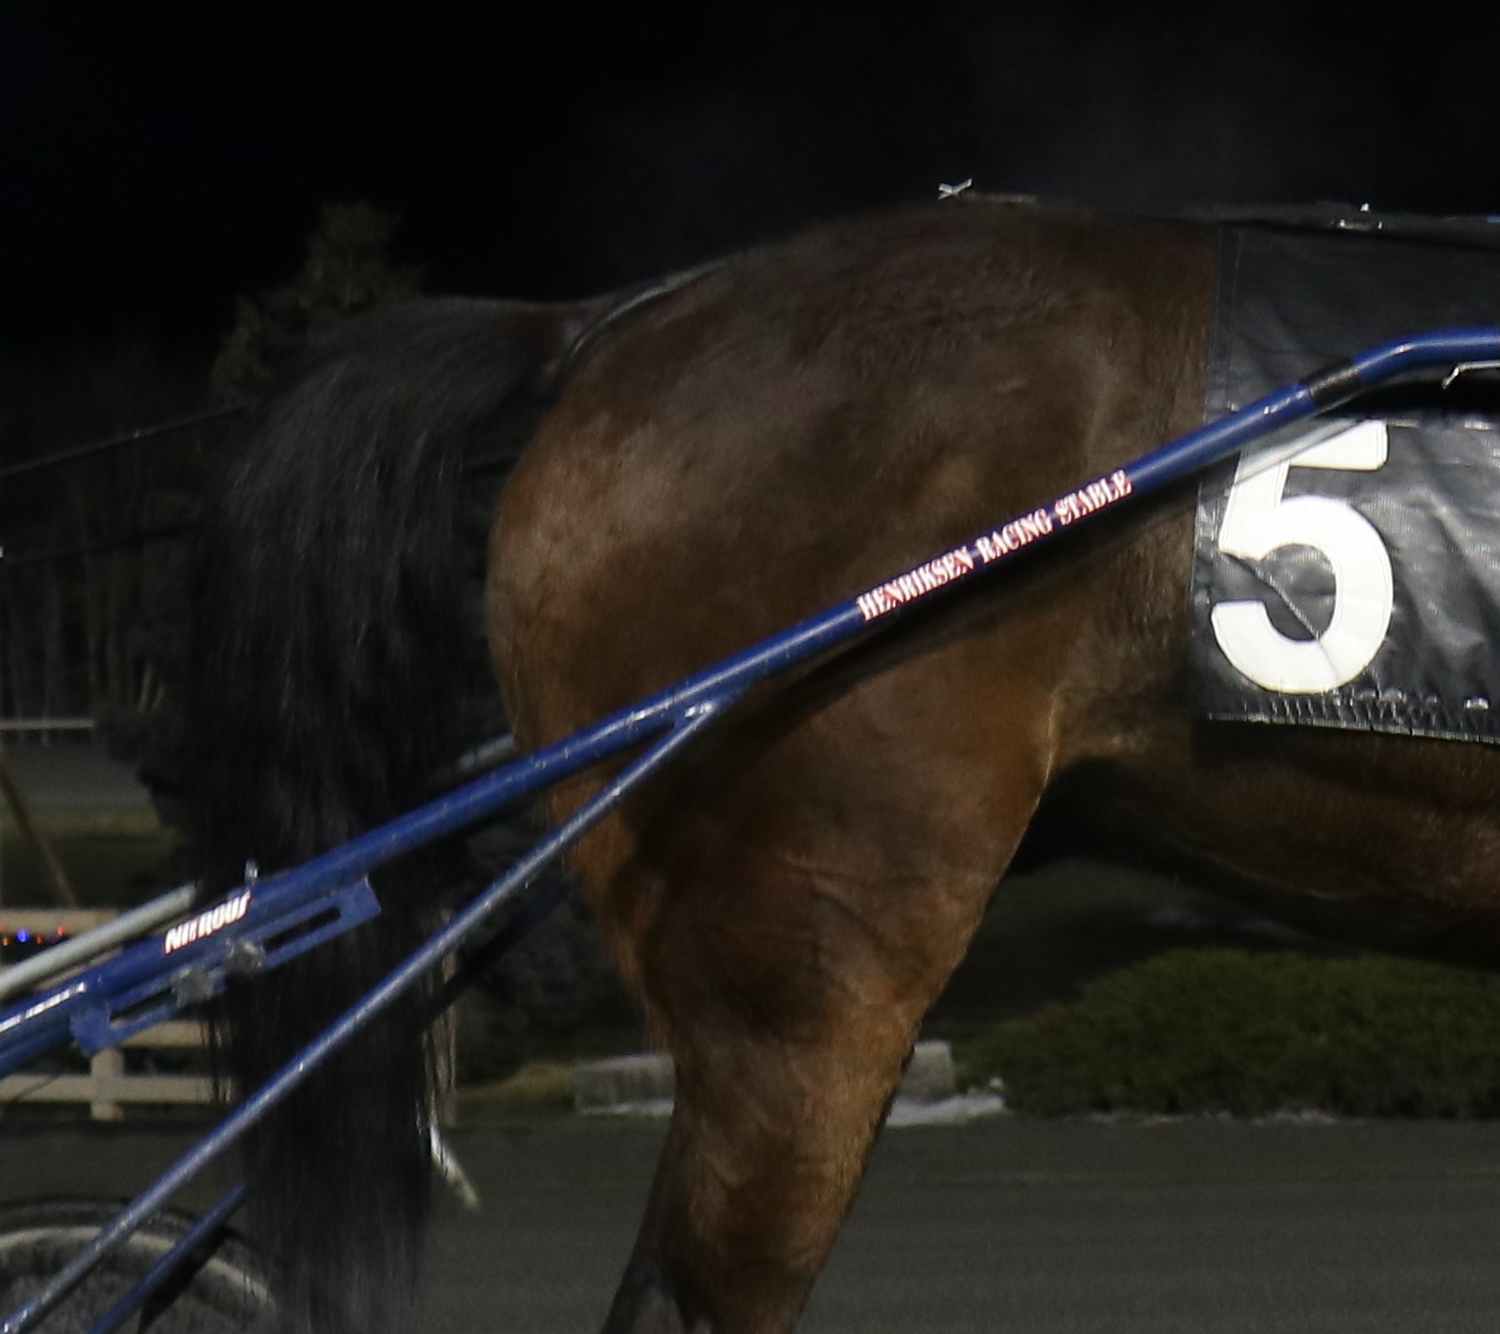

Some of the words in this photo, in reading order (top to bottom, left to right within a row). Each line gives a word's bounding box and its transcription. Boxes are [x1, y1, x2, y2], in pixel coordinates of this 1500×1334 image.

[856, 546, 975, 622] HENRIKSEN
[975, 509, 1054, 564] RACING
[1054, 470, 1133, 525] STABLE
[1211, 421, 1393, 694] 5
